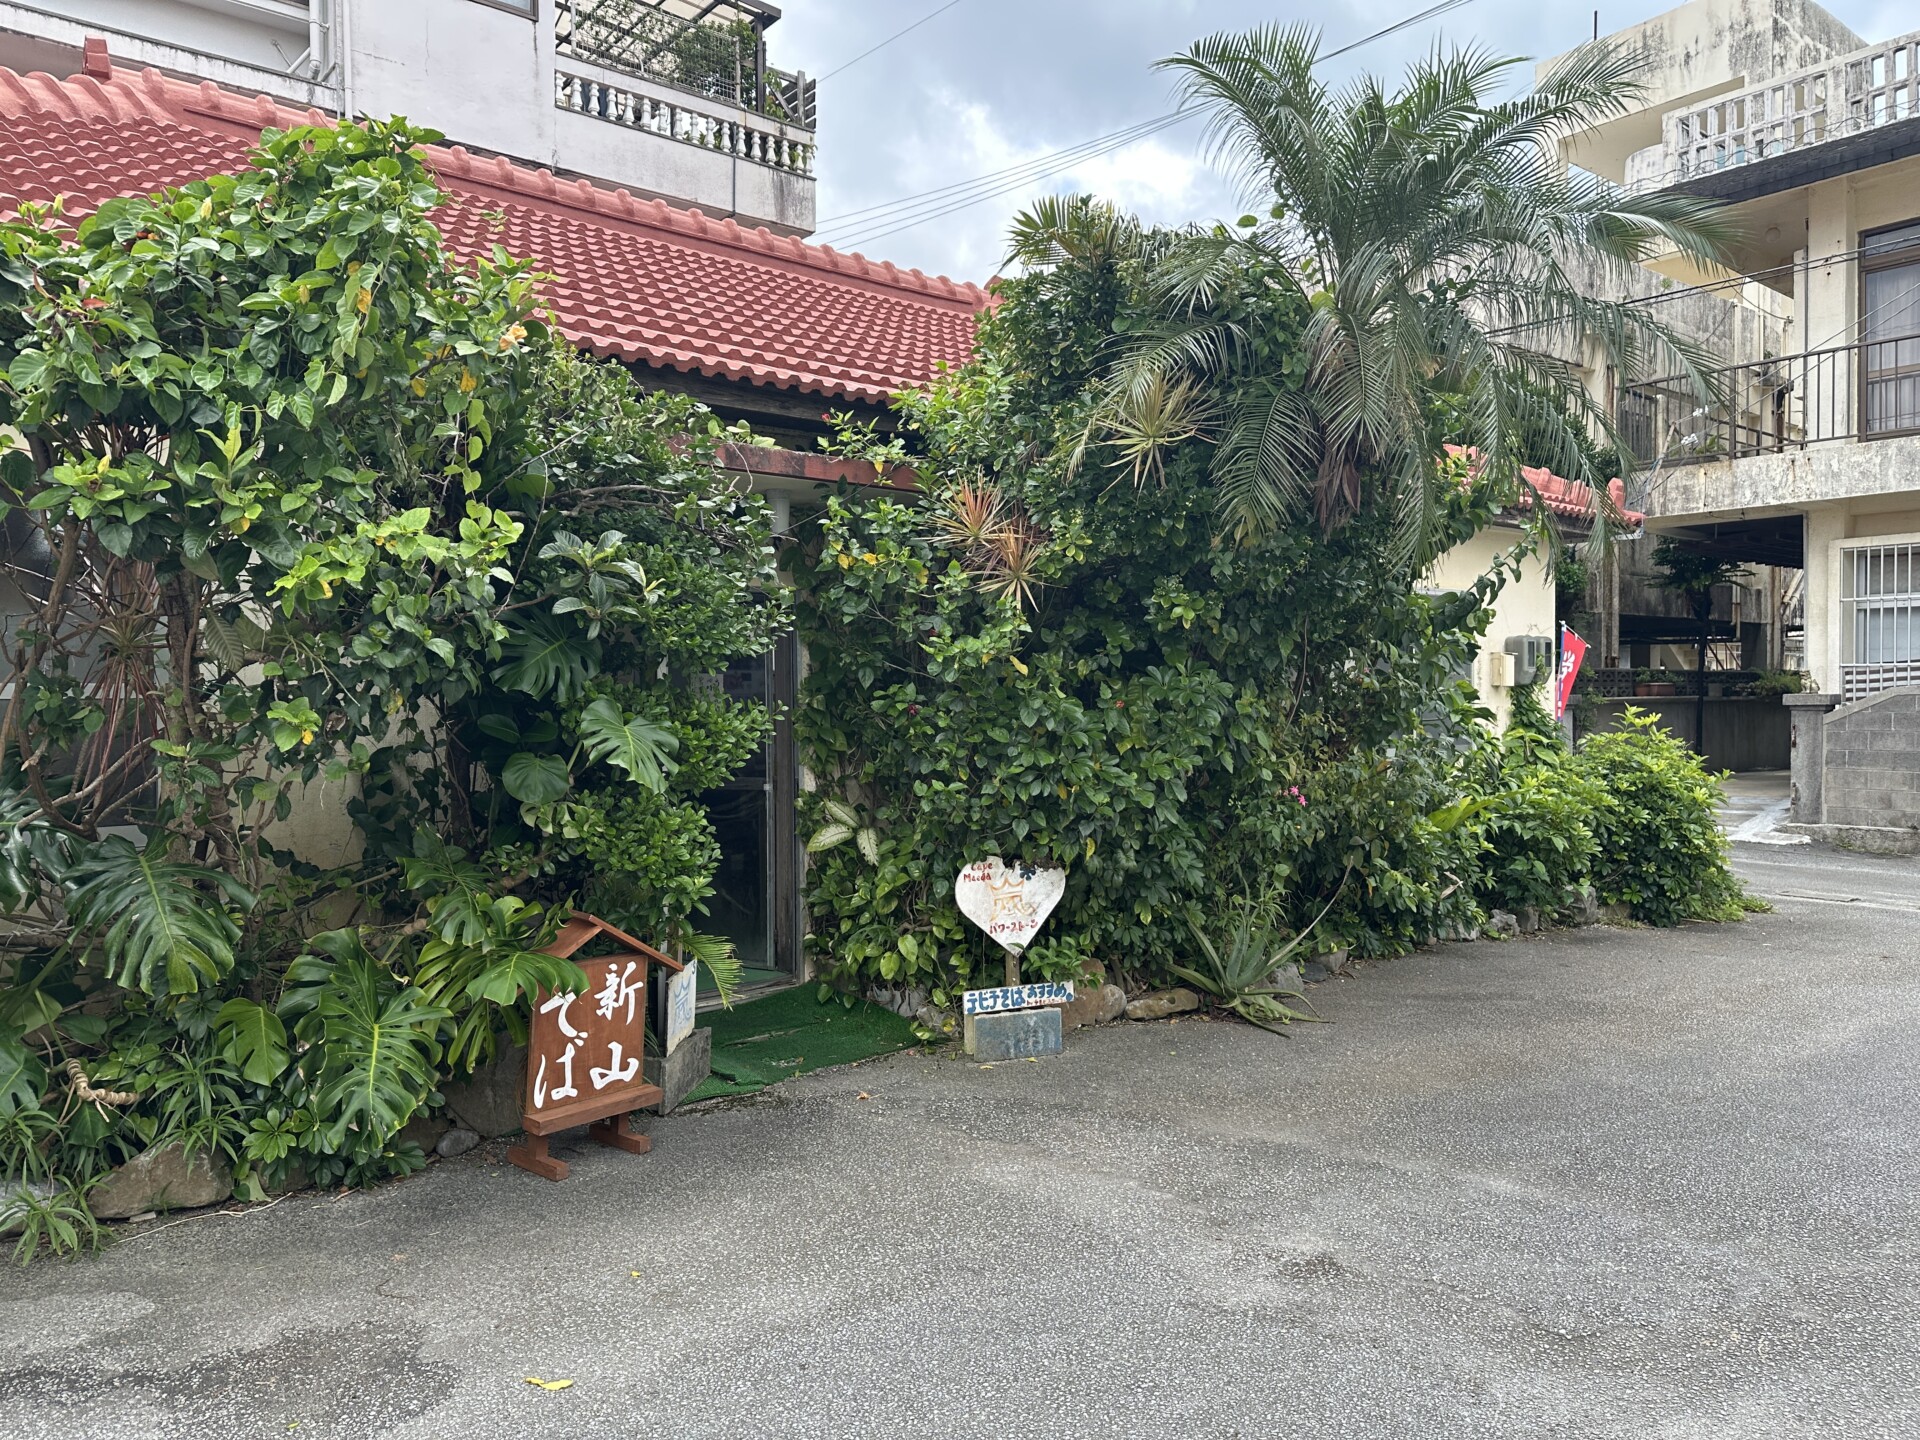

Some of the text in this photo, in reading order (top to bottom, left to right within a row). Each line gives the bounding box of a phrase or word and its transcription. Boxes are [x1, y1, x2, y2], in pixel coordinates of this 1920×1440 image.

[589, 961, 644, 1090] 新山
[966, 985, 1026, 1015] テビチそば
